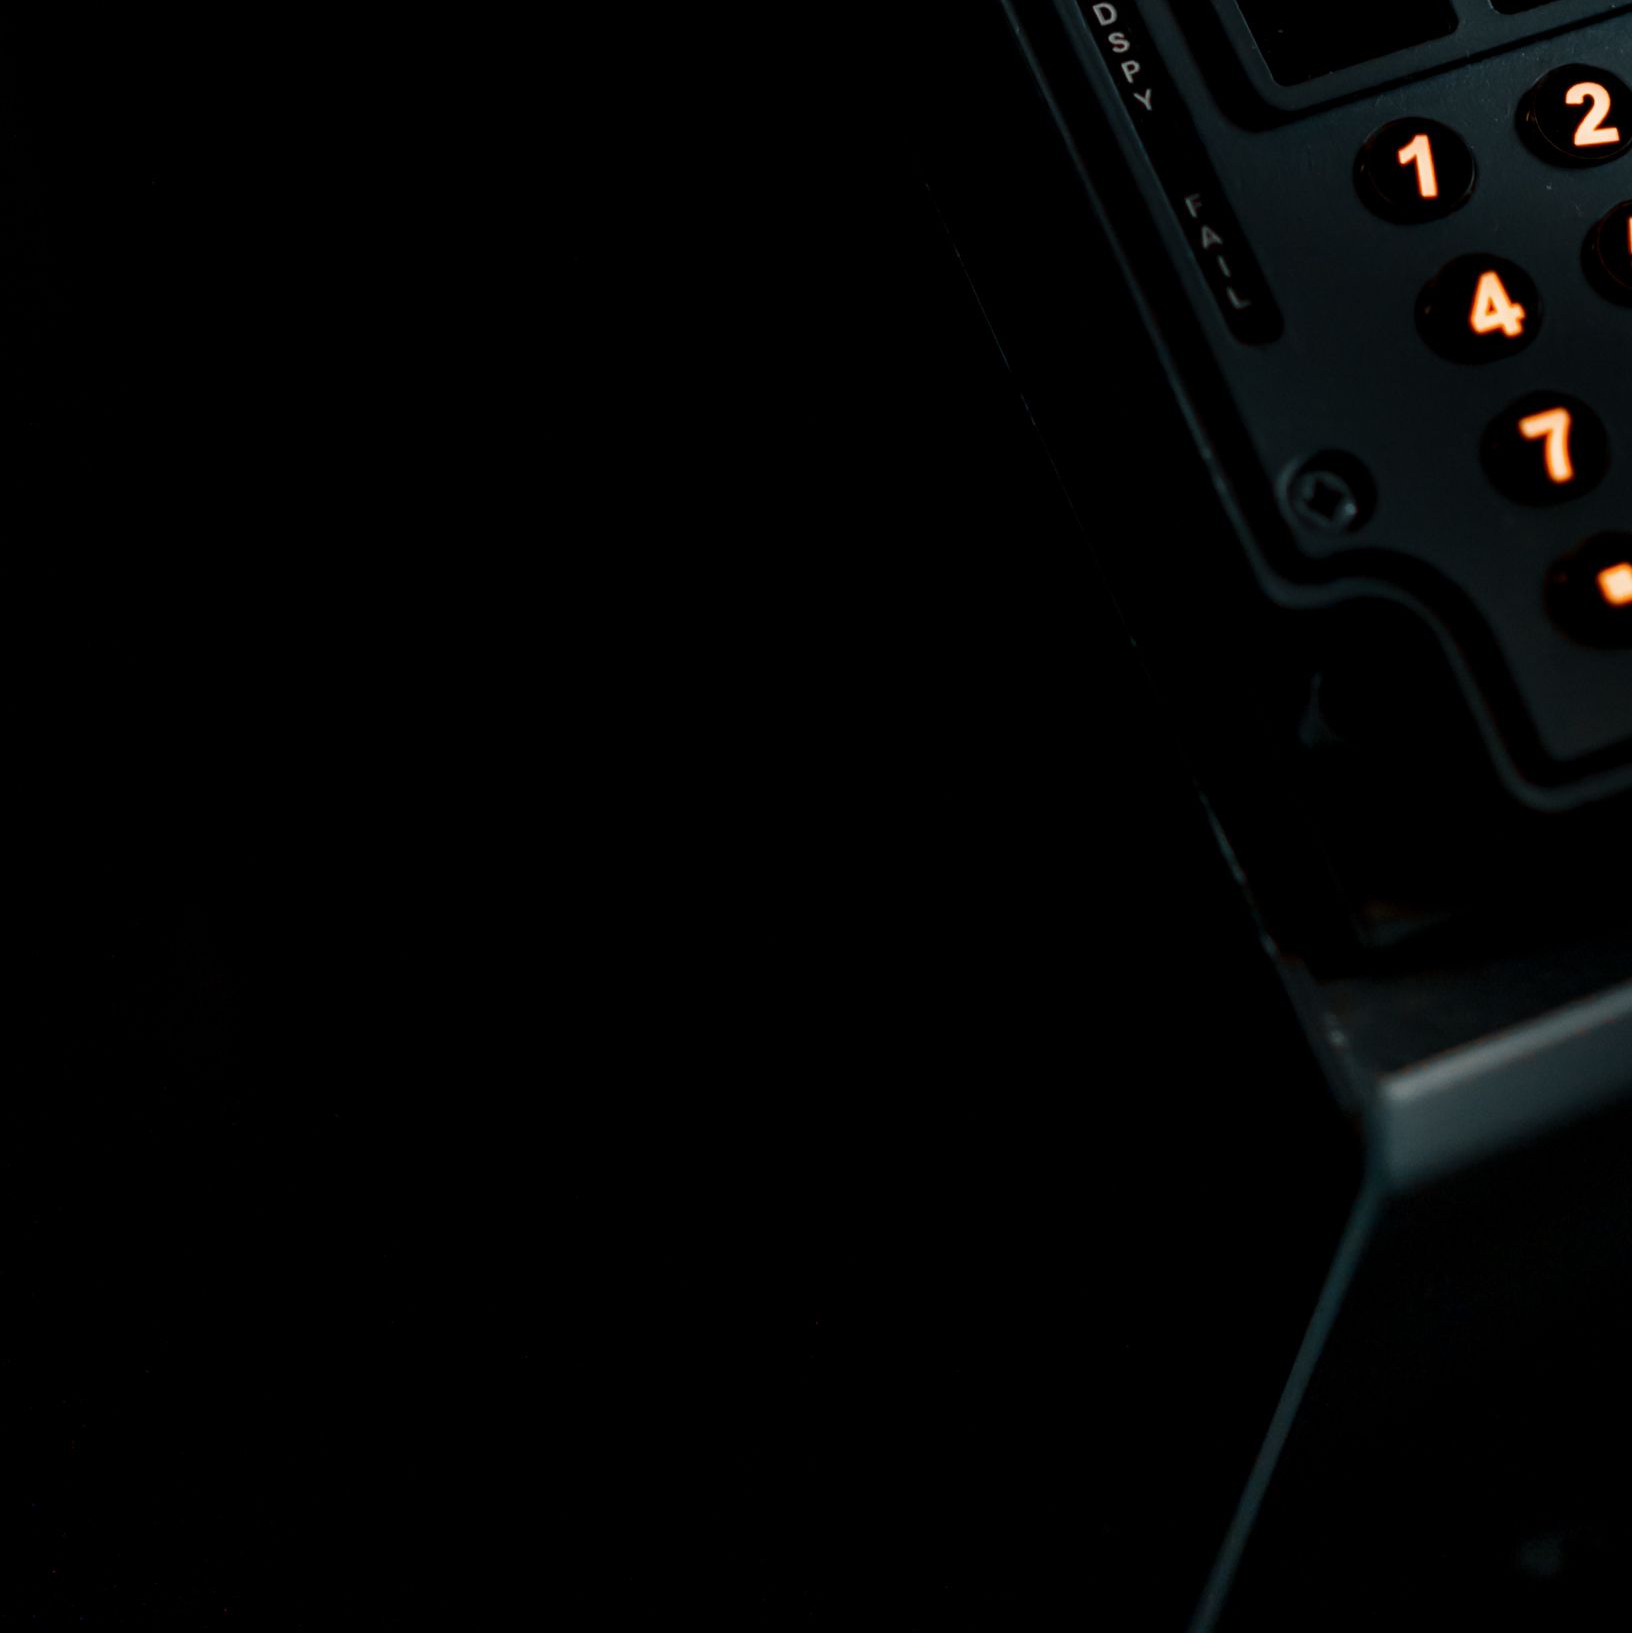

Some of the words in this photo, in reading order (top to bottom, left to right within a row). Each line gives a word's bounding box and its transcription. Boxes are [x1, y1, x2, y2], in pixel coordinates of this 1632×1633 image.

[1093, 2, 1152, 110] DSPY
[1565, 82, 1619, 146] 2
[1398, 134, 1438, 198] 1
[1470, 271, 1525, 337] 4
[1519, 408, 1573, 482] 7
